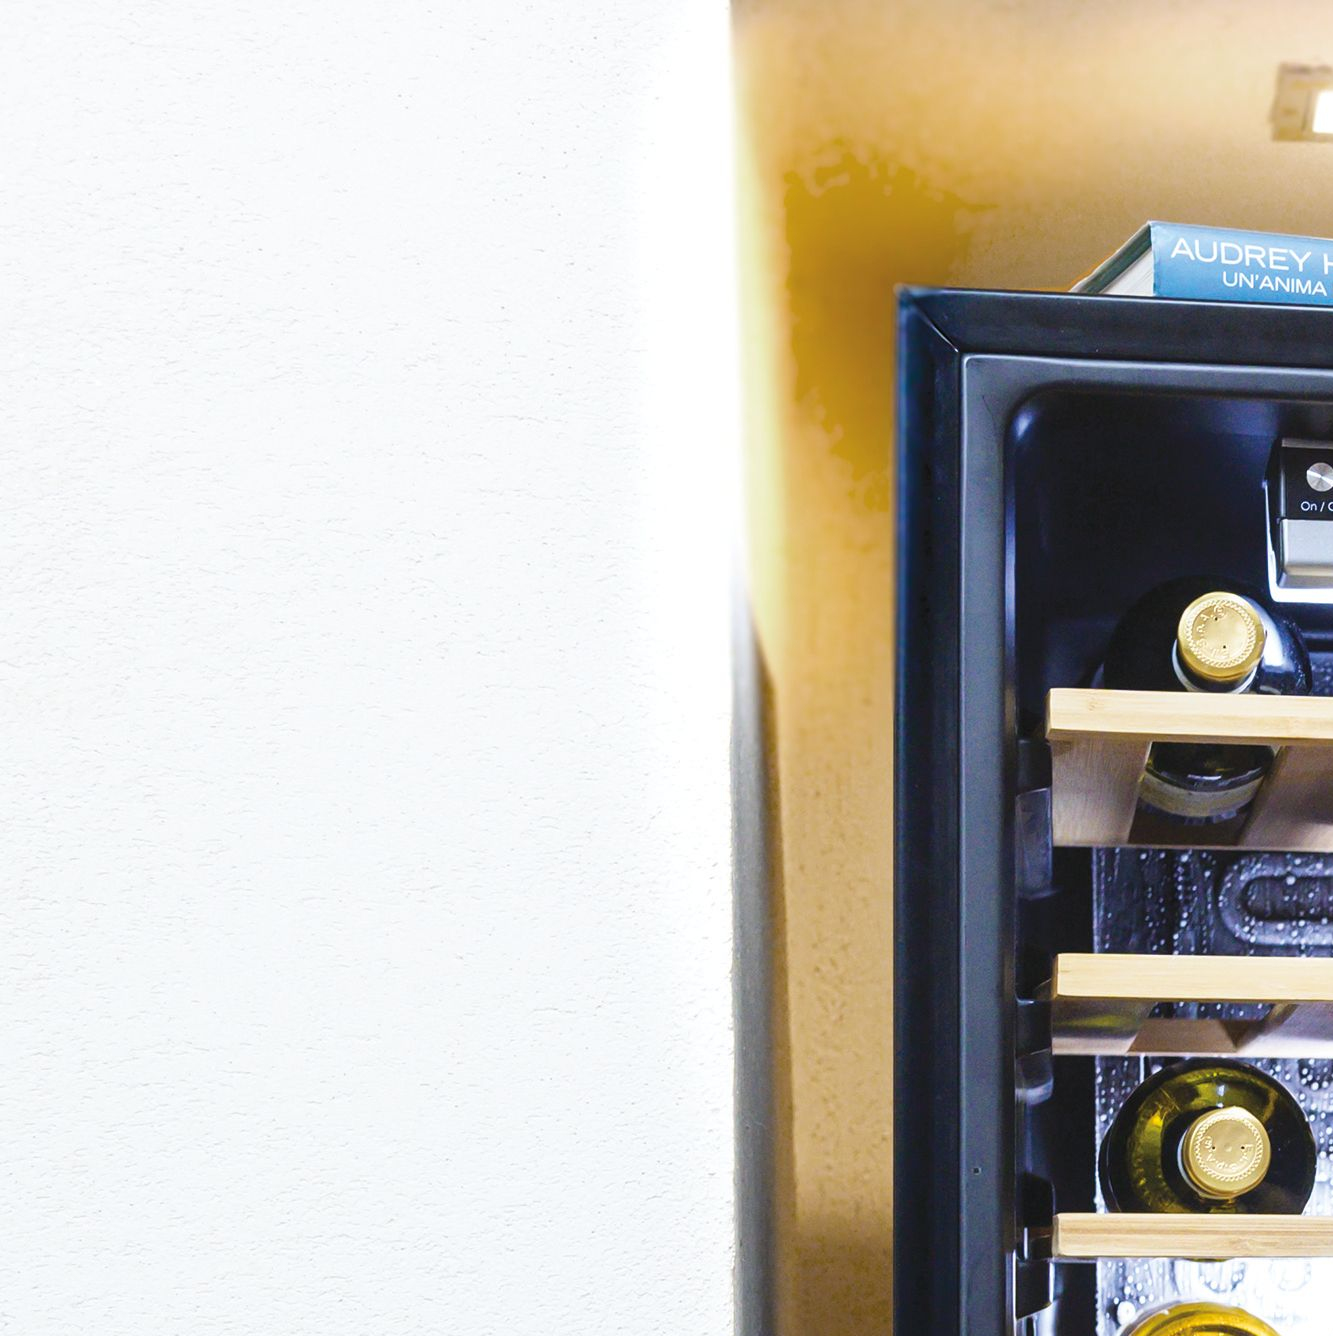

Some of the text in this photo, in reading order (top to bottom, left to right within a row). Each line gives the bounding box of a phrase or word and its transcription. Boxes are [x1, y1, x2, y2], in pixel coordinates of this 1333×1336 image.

[1170, 237, 1312, 272] AUDREY
[1222, 271, 1327, 297] UN'ANIMA
[1300, 501, 1318, 512] On
